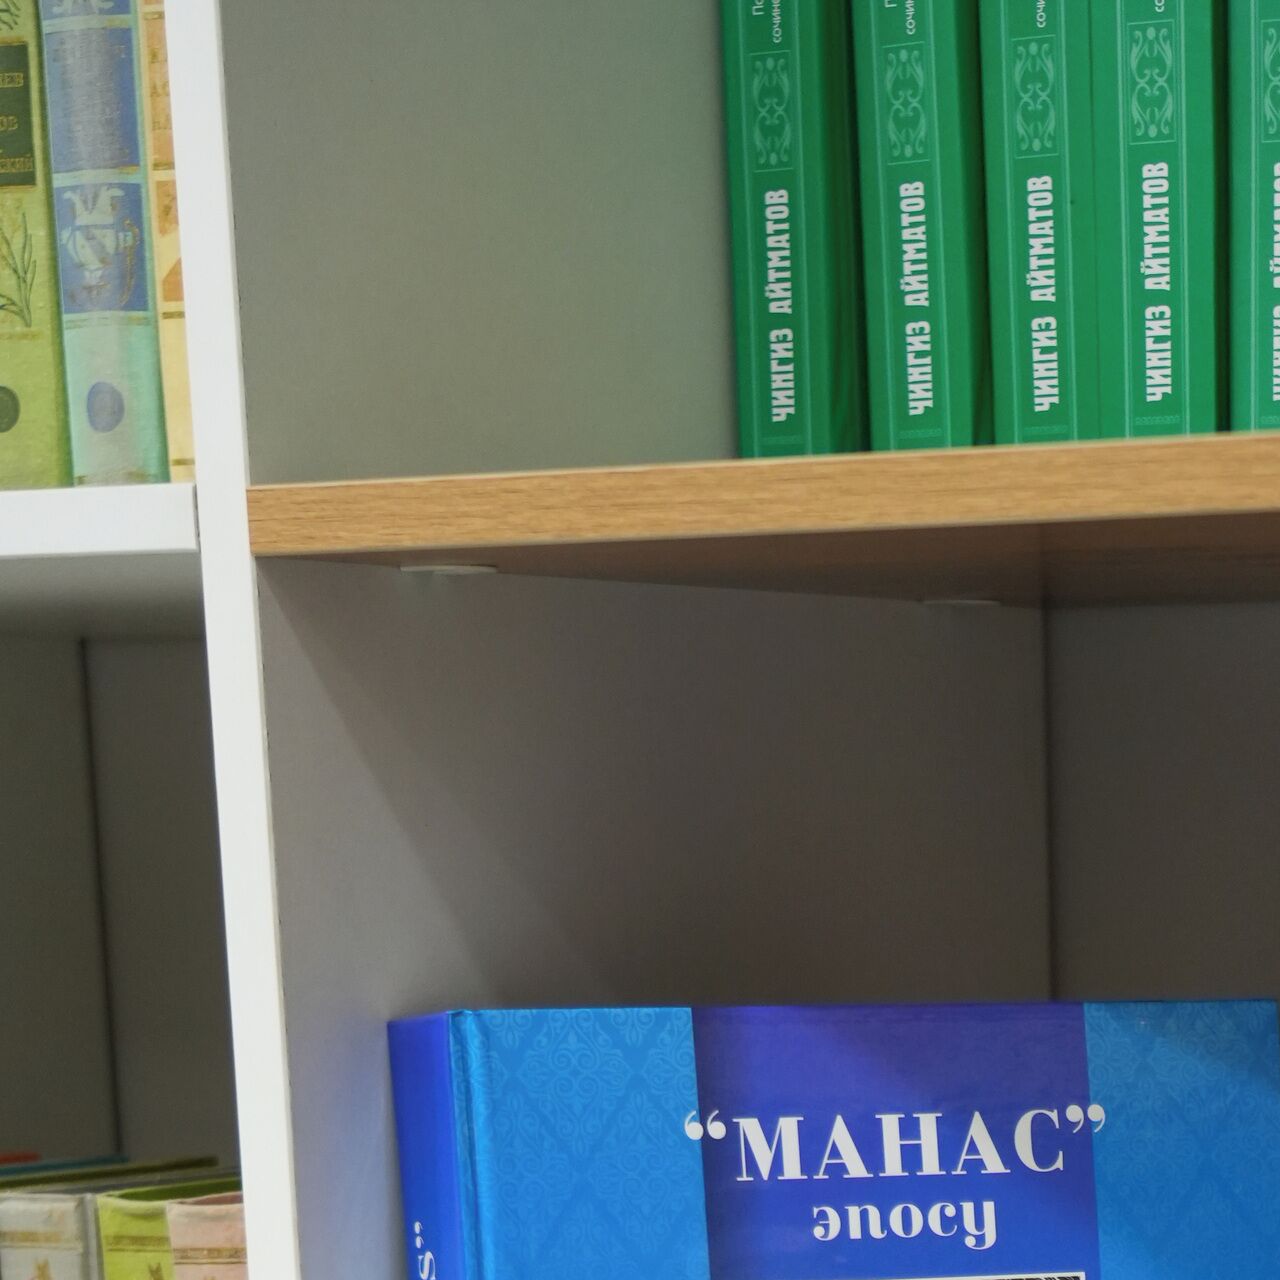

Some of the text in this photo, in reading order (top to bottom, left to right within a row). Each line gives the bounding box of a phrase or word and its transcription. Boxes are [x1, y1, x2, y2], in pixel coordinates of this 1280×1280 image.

[764, 189, 795, 422] ЧИНГИЗ АЙТМАТОВ
[899, 182, 933, 416] ЧИНГИЗ АЙТМАТОВ
[1027, 175, 1059, 412] ЧИНГИЗ АЙТМАТОВ
[1141, 162, 1171, 402] ЧИНГИЗ АЙТМАТОВ
[813, 1197, 997, 1250] эпосу
